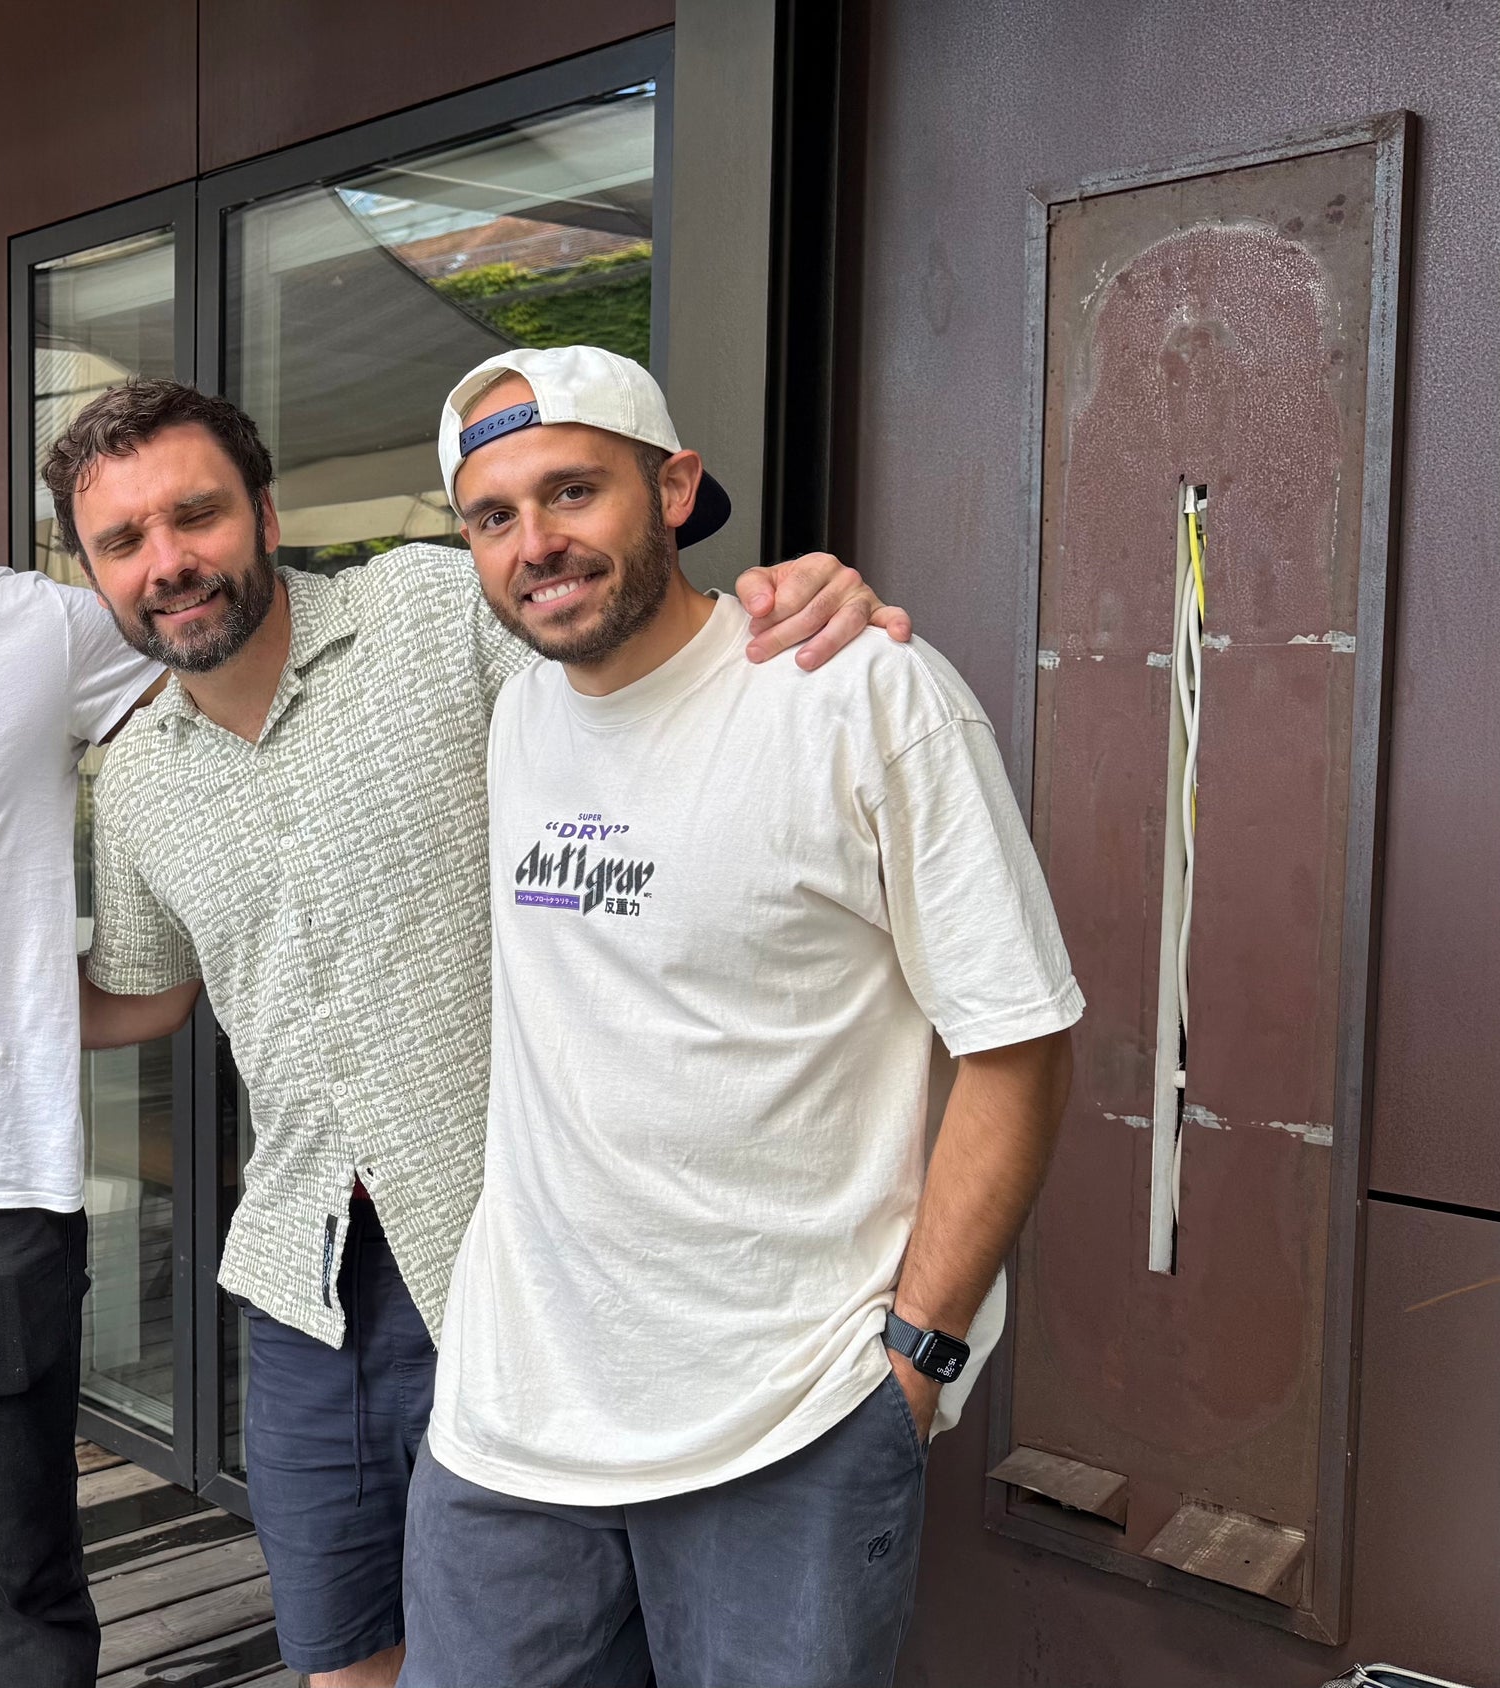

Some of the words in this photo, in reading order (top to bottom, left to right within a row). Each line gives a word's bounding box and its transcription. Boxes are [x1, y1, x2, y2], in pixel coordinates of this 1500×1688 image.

[577, 813, 602, 821] SUPER
[515, 840, 655, 916] Antigrav
[604, 897, 640, 916] 反重力
